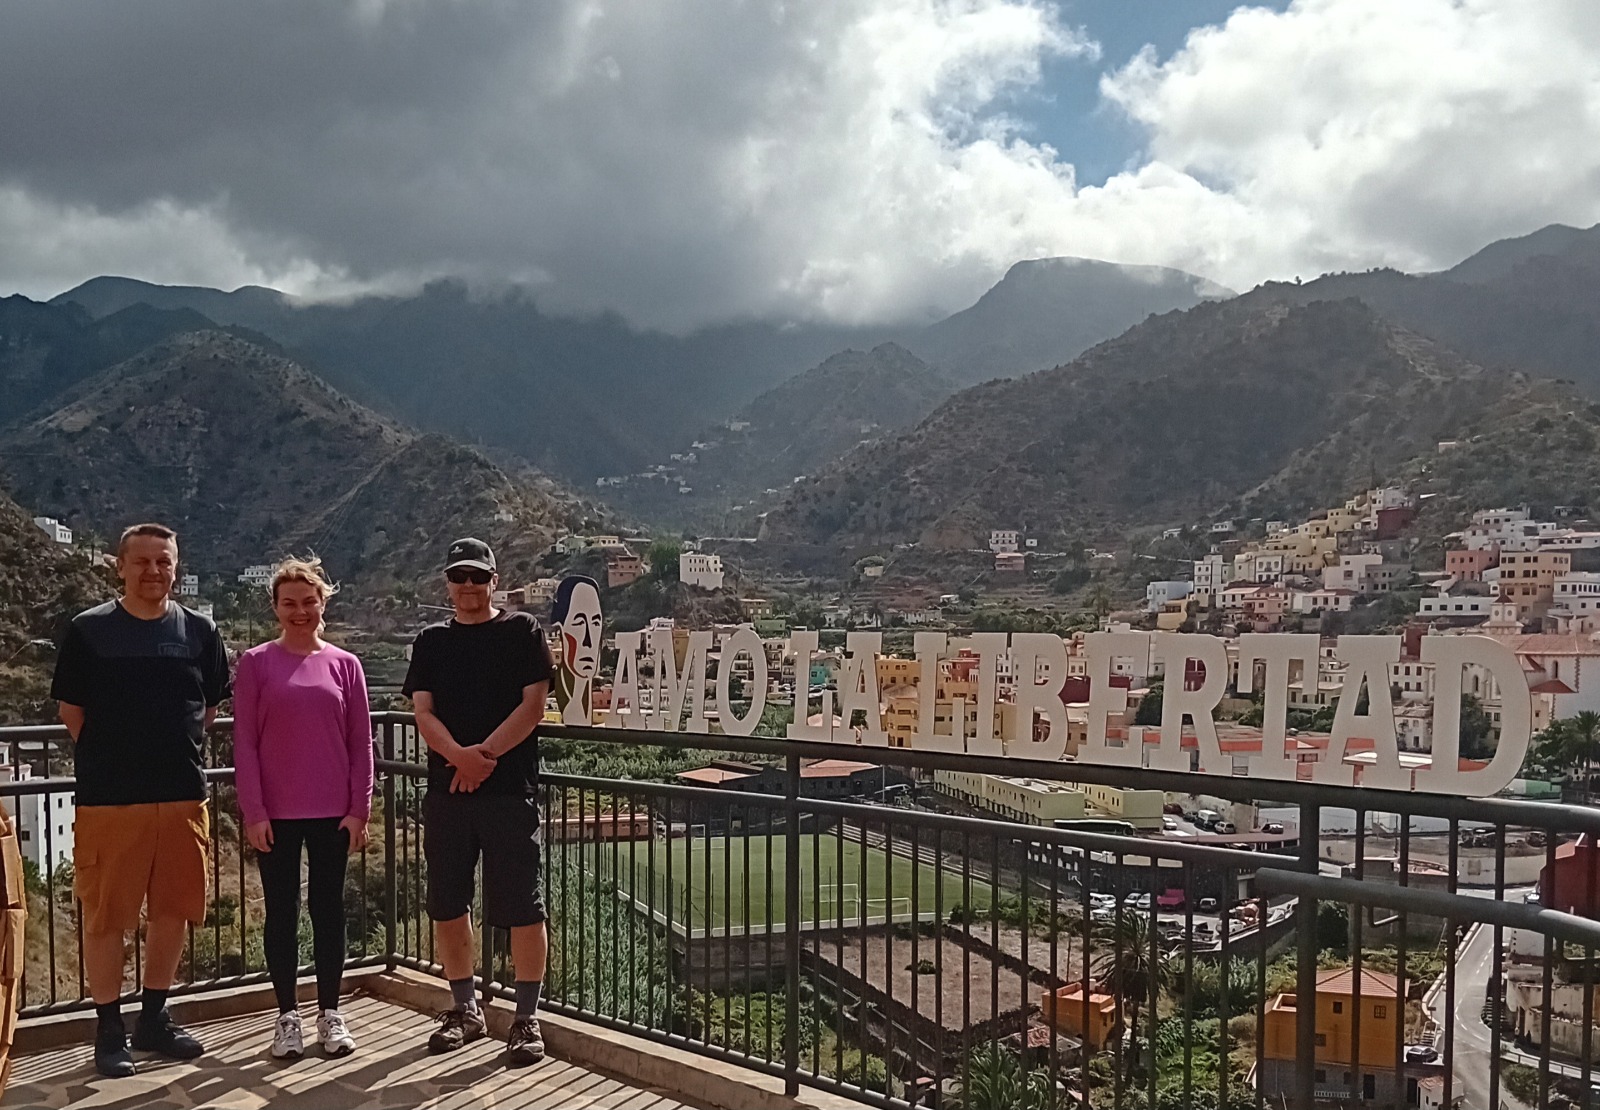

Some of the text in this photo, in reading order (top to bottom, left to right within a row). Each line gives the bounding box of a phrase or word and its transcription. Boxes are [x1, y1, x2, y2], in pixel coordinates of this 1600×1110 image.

[607, 624, 1531, 797] AMO LA LIBERTAD
